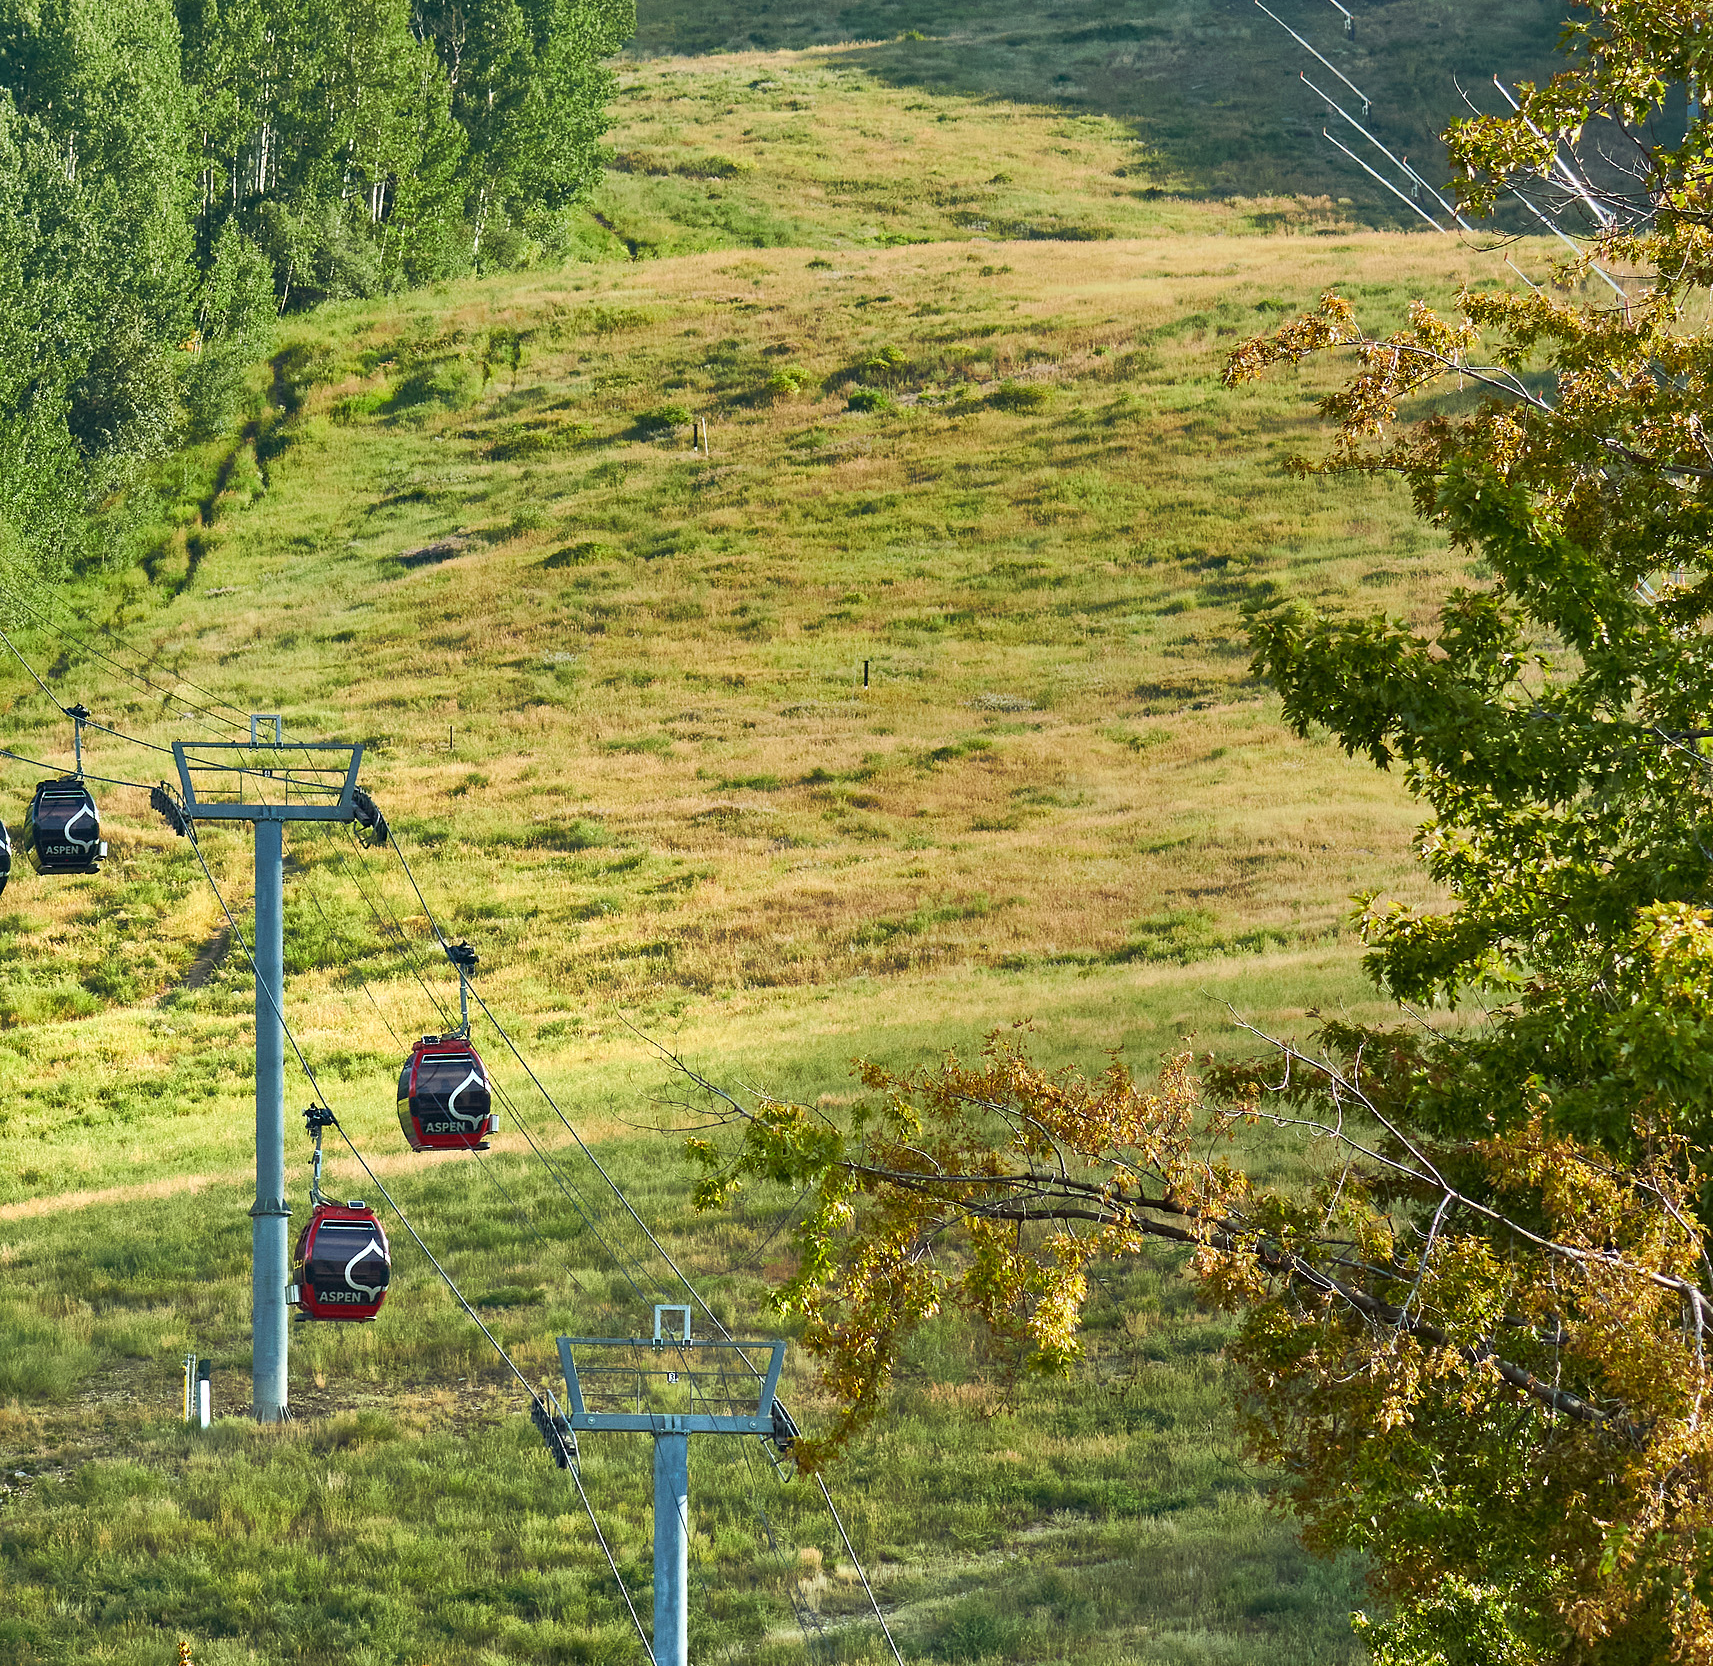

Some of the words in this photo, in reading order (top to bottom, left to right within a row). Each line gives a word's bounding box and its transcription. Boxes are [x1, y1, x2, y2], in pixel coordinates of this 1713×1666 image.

[46, 845, 78, 854] ASPEN
[426, 1122, 465, 1132] ASPEN
[319, 1292, 361, 1302] ASPEN
